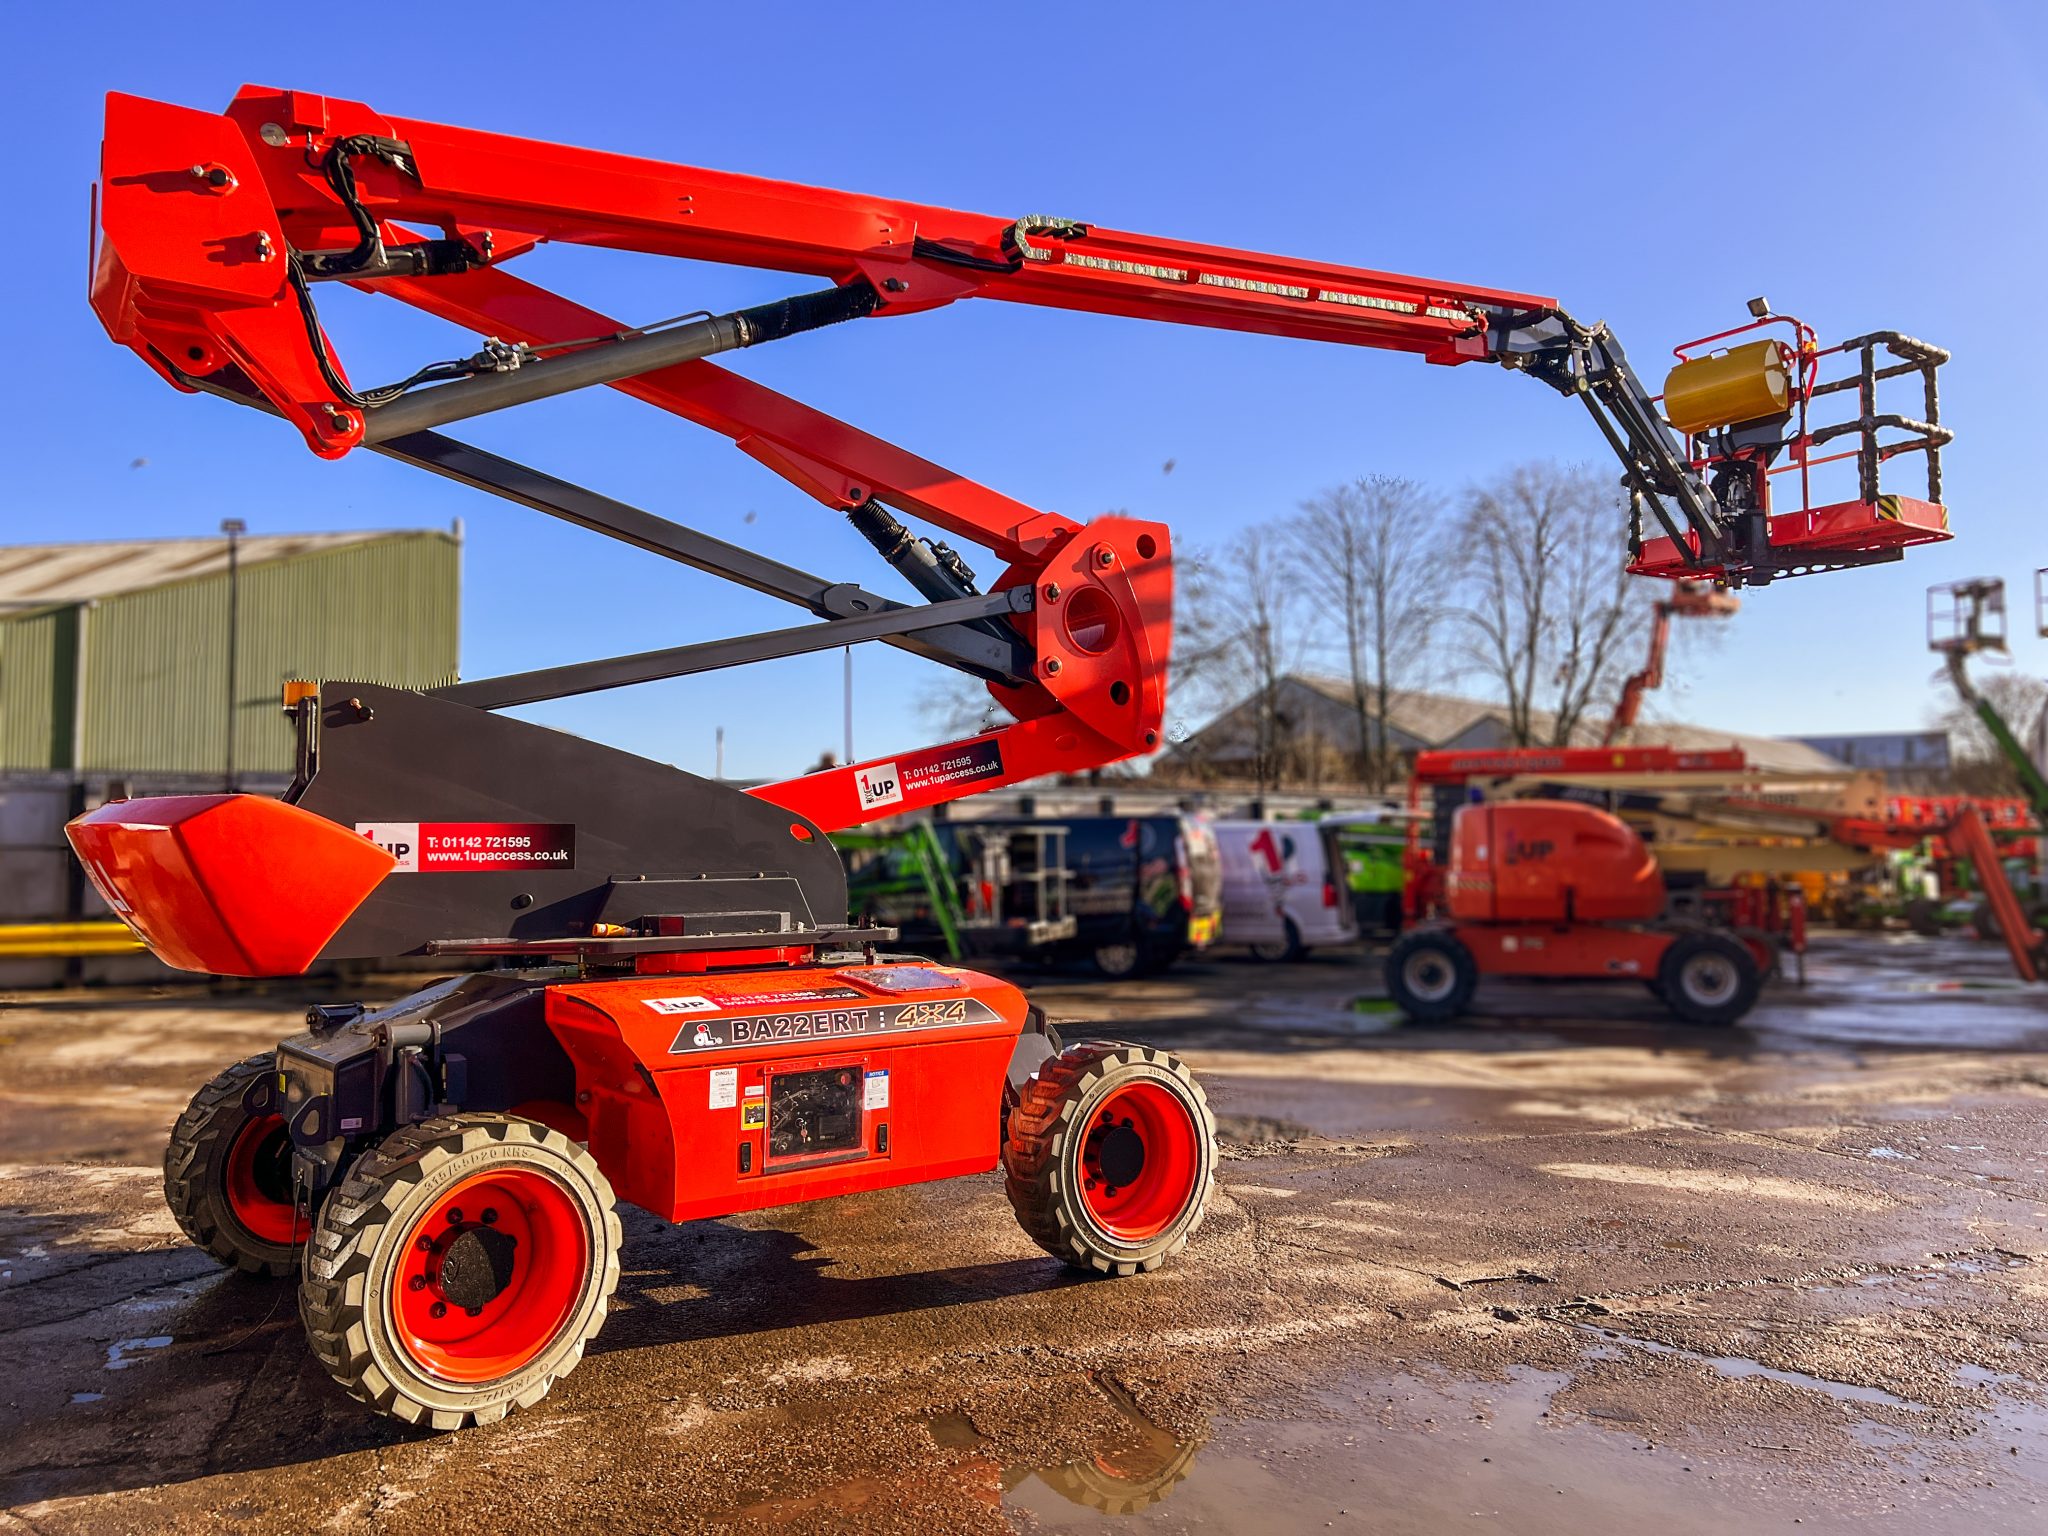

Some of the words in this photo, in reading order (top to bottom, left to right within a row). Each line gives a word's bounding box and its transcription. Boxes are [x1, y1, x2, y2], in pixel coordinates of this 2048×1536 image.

[905, 760, 999, 791] www.1upaccess.co.uk
[913, 763, 939, 779] 01142
[940, 755, 972, 771] 721595
[426, 836, 439, 848] T:
[442, 836, 482, 848] 01142
[485, 836, 531, 848] 721595
[426, 849, 568, 863] www.1upaccess.co.uk
[731, 1009, 870, 1043] BA22ERT
